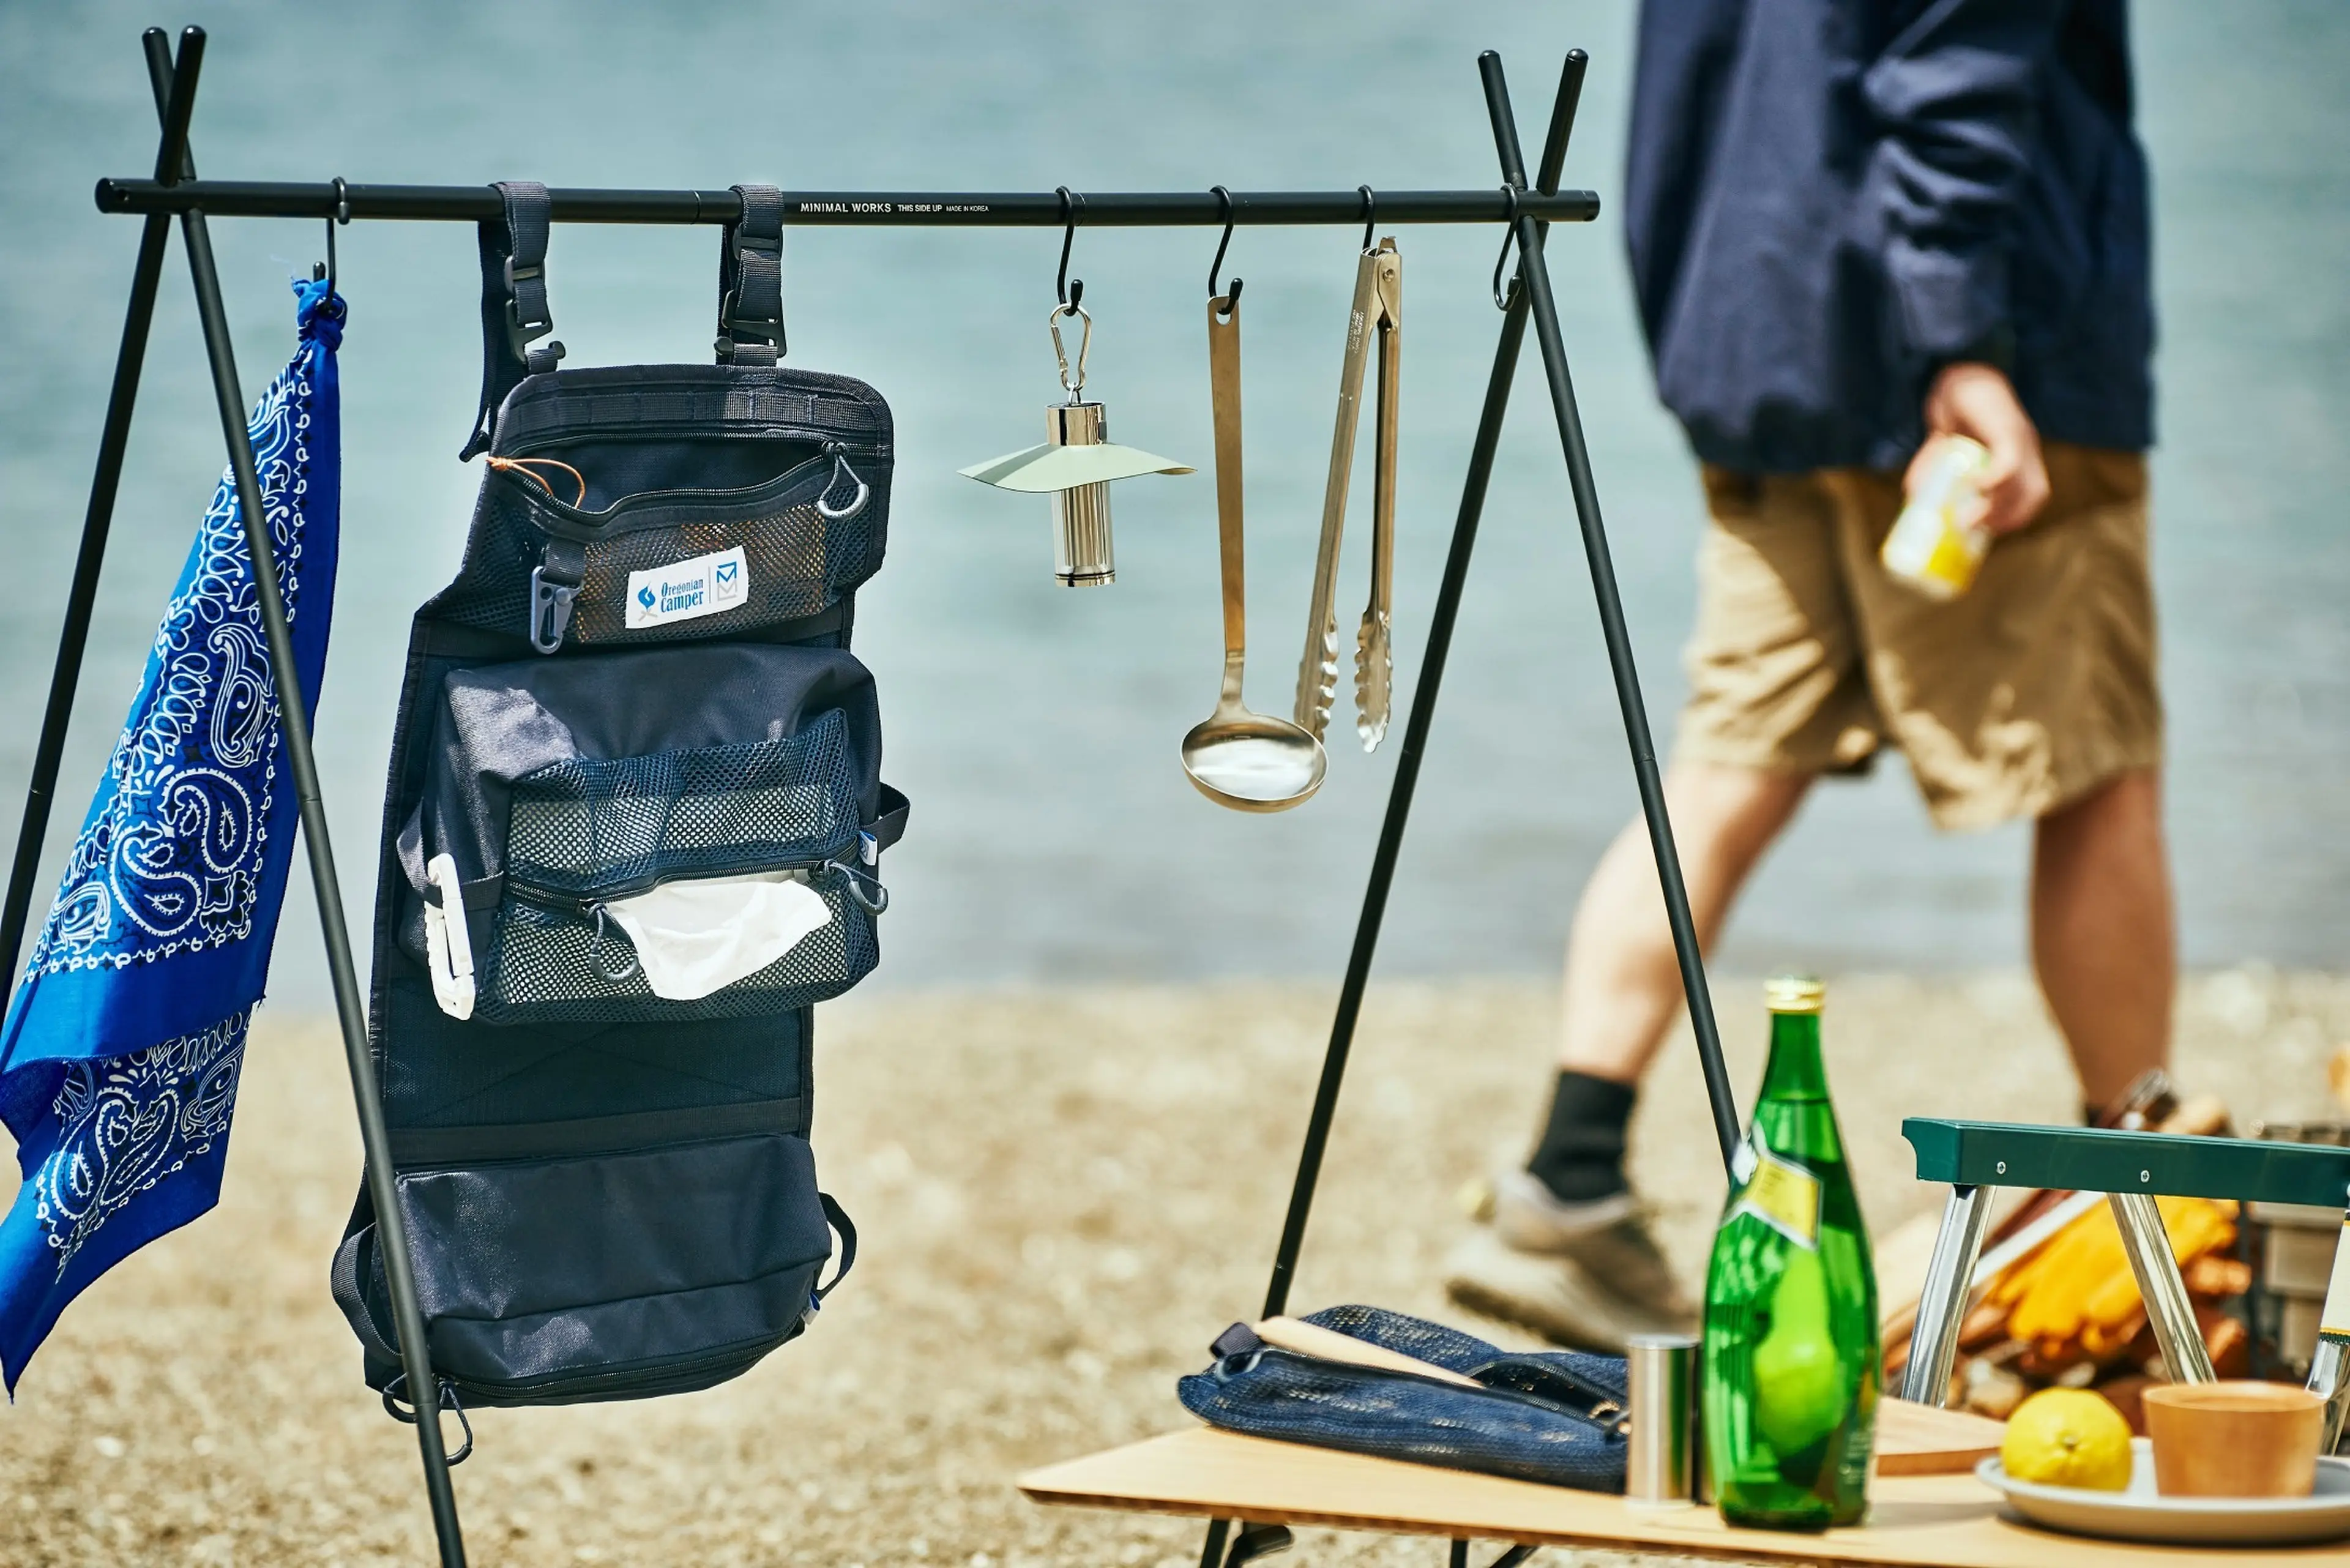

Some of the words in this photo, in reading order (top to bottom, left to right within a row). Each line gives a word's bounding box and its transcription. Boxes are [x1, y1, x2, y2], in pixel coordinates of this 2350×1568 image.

[800, 203, 848, 212] MINIMAL
[851, 203, 892, 212] WORKS
[661, 579, 703, 597] Oregonian
[661, 591, 704, 613] Camper
